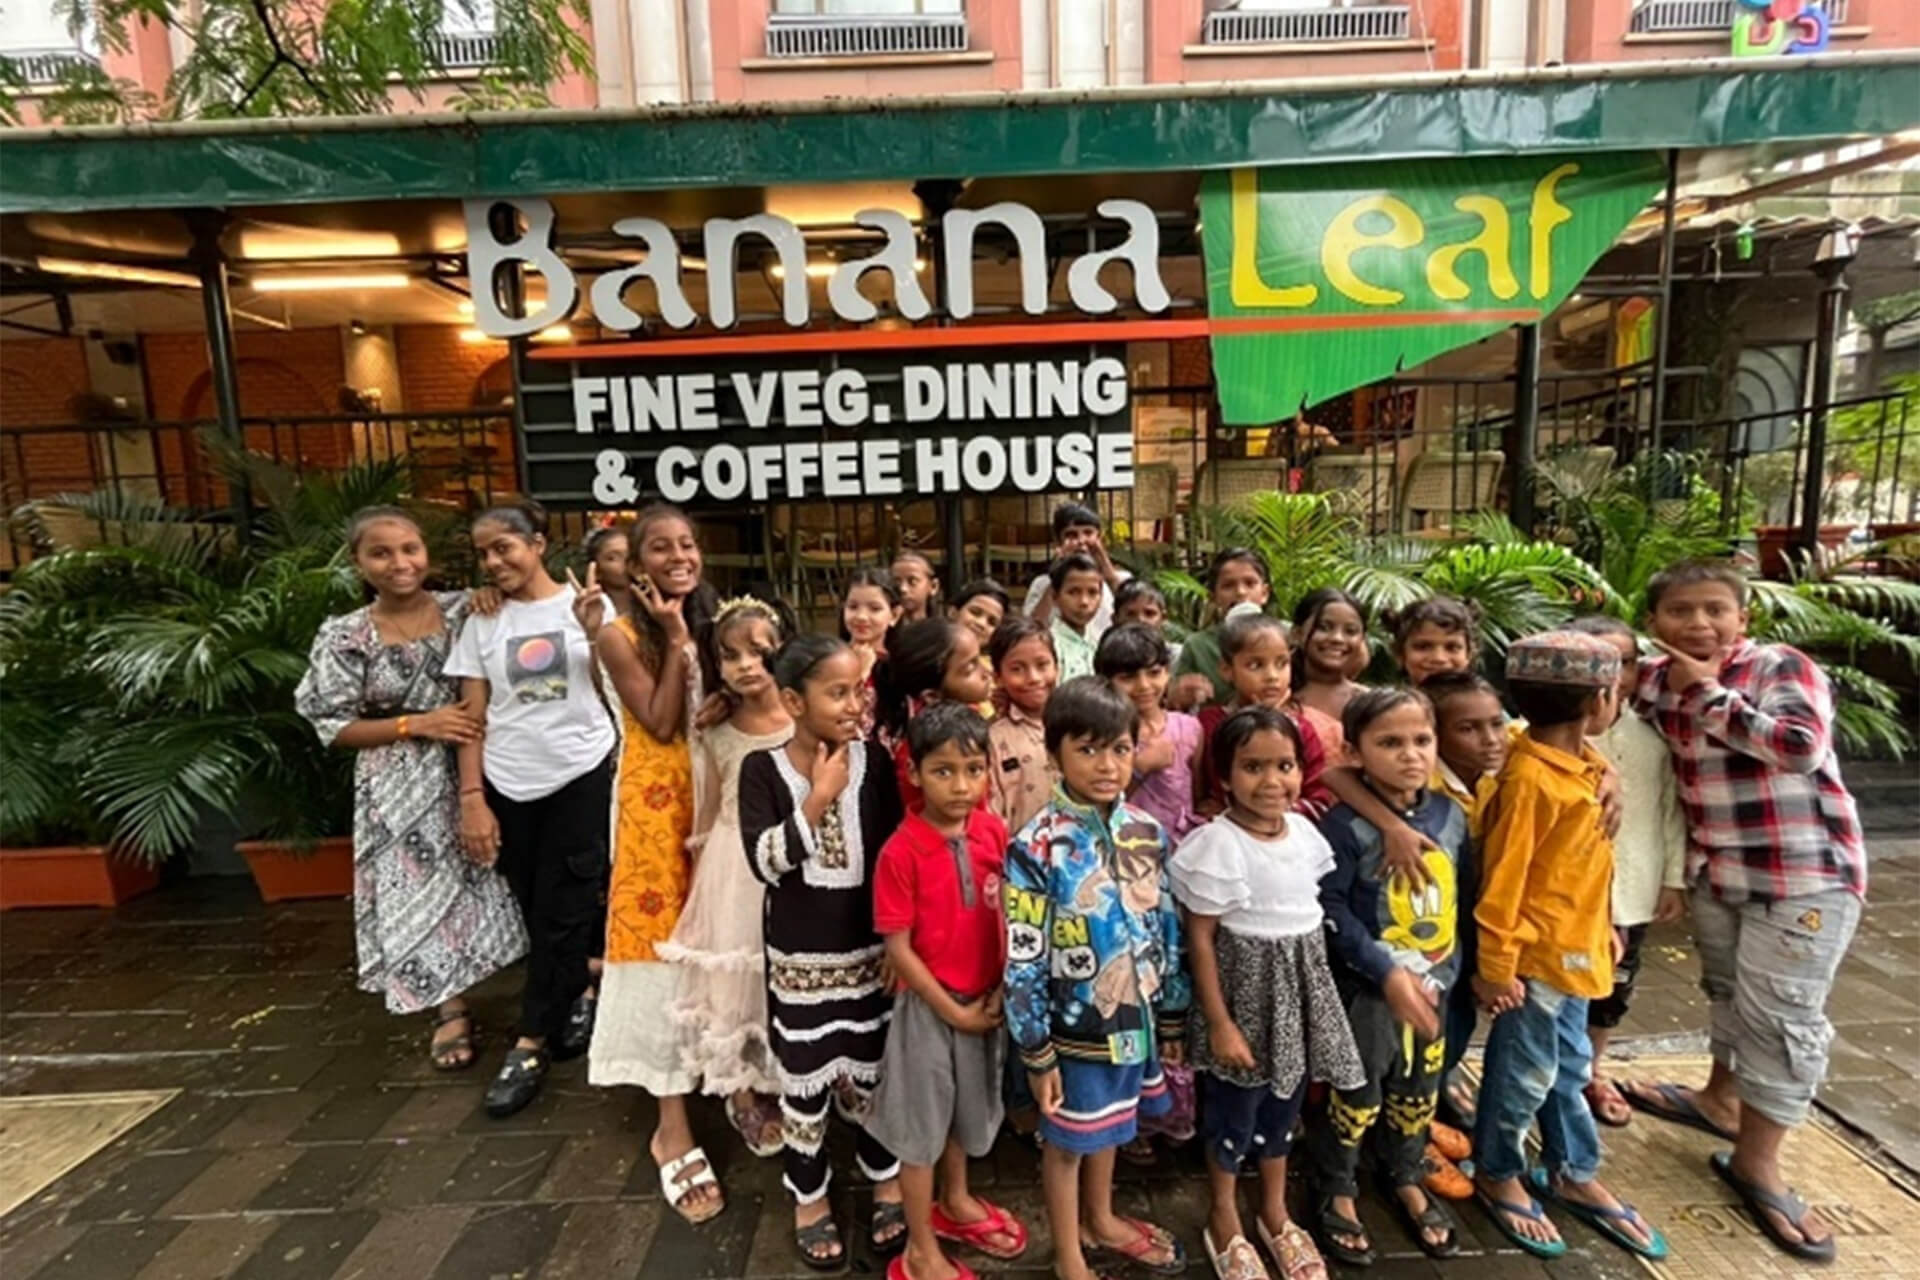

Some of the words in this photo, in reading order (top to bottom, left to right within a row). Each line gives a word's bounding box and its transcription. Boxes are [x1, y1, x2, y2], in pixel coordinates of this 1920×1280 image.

[463, 199, 1171, 337] Banana
[1231, 162, 1580, 307] Leaf
[572, 374, 719, 433] FINE
[731, 369, 891, 429] VEG.
[903, 357, 1128, 422] DINING
[592, 449, 640, 505] &
[655, 440, 902, 502] COFFEE
[916, 432, 1135, 493] HOUSE
